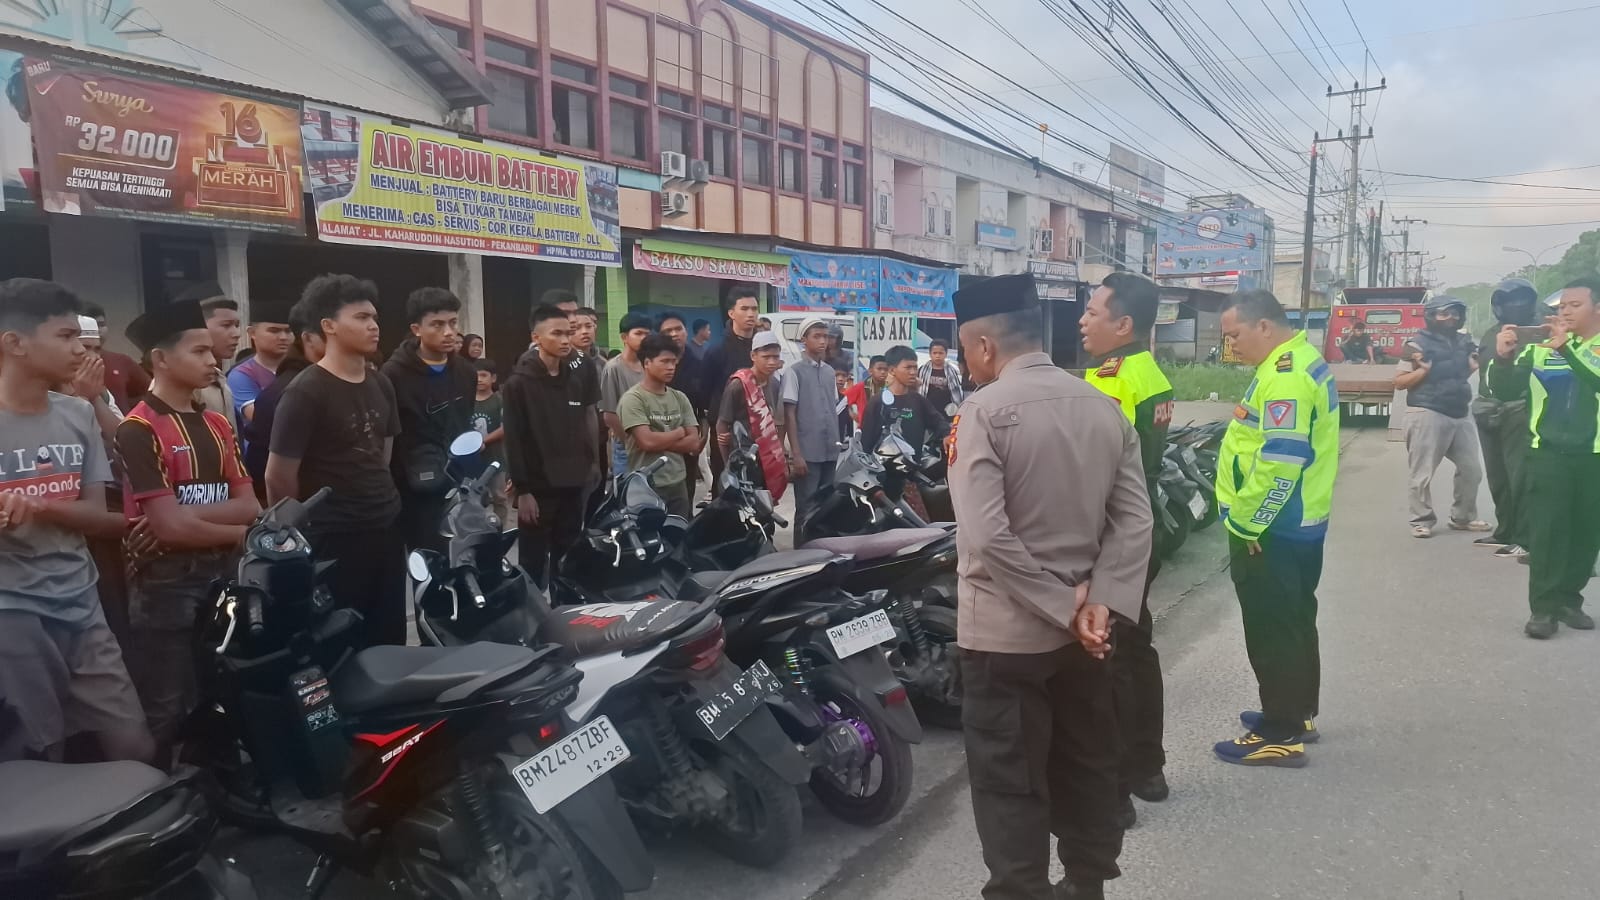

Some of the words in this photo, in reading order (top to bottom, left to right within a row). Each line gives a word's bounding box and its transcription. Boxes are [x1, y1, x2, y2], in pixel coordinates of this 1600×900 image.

[26, 61, 51, 77] BARU
[82, 81, 153, 117] Surya
[65, 115, 81, 128] RP
[219, 102, 263, 144] 16
[78, 122, 174, 162] 32.000
[72, 167, 120, 182] KEPUASAN
[122, 173, 165, 187] TERTINGGI
[204, 169, 273, 188] MERAH
[371, 130, 415, 174] AIR
[418, 139, 493, 188] EMBUN
[496, 155, 579, 200] BATTERY
[66, 177, 99, 190] SEMUA
[101, 180, 121, 192] BISA
[123, 183, 172, 198] MENIKMATI
[370, 174, 423, 195] MENJUAL
[432, 183, 478, 202] BATTERY
[480, 191, 505, 206] BARU
[508, 195, 551, 212] BERBAGAI
[554, 203, 581, 217] MEREK
[342, 202, 404, 223] MENERIMA
[413, 211, 435, 226] CAS
[444, 217, 480, 232] SERVIS
[487, 221, 507, 235] COR
[509, 224, 542, 239] KEPALA
[544, 227, 580, 243] BATTERY
[436, 199, 460, 214] BISA
[463, 203, 494, 219] TUKAR
[497, 206, 535, 224] TAMBAH
[322, 224, 360, 237] ALAMAT
[368, 229, 381, 240] JL.
[384, 230, 442, 245] KAHARUDDIN
[444, 235, 485, 249] NASUTION
[491, 240, 535, 253] PEKANBARU
[650, 252, 704, 271] BAKSO
[709, 258, 766, 278] SRAGEN
[862, 316, 886, 341] CAS
[889, 316, 912, 341] AKI
[13, 444, 84, 473] LVE
[1251, 477, 1293, 526] POLISI
[381, 731, 424, 764] BEAT
